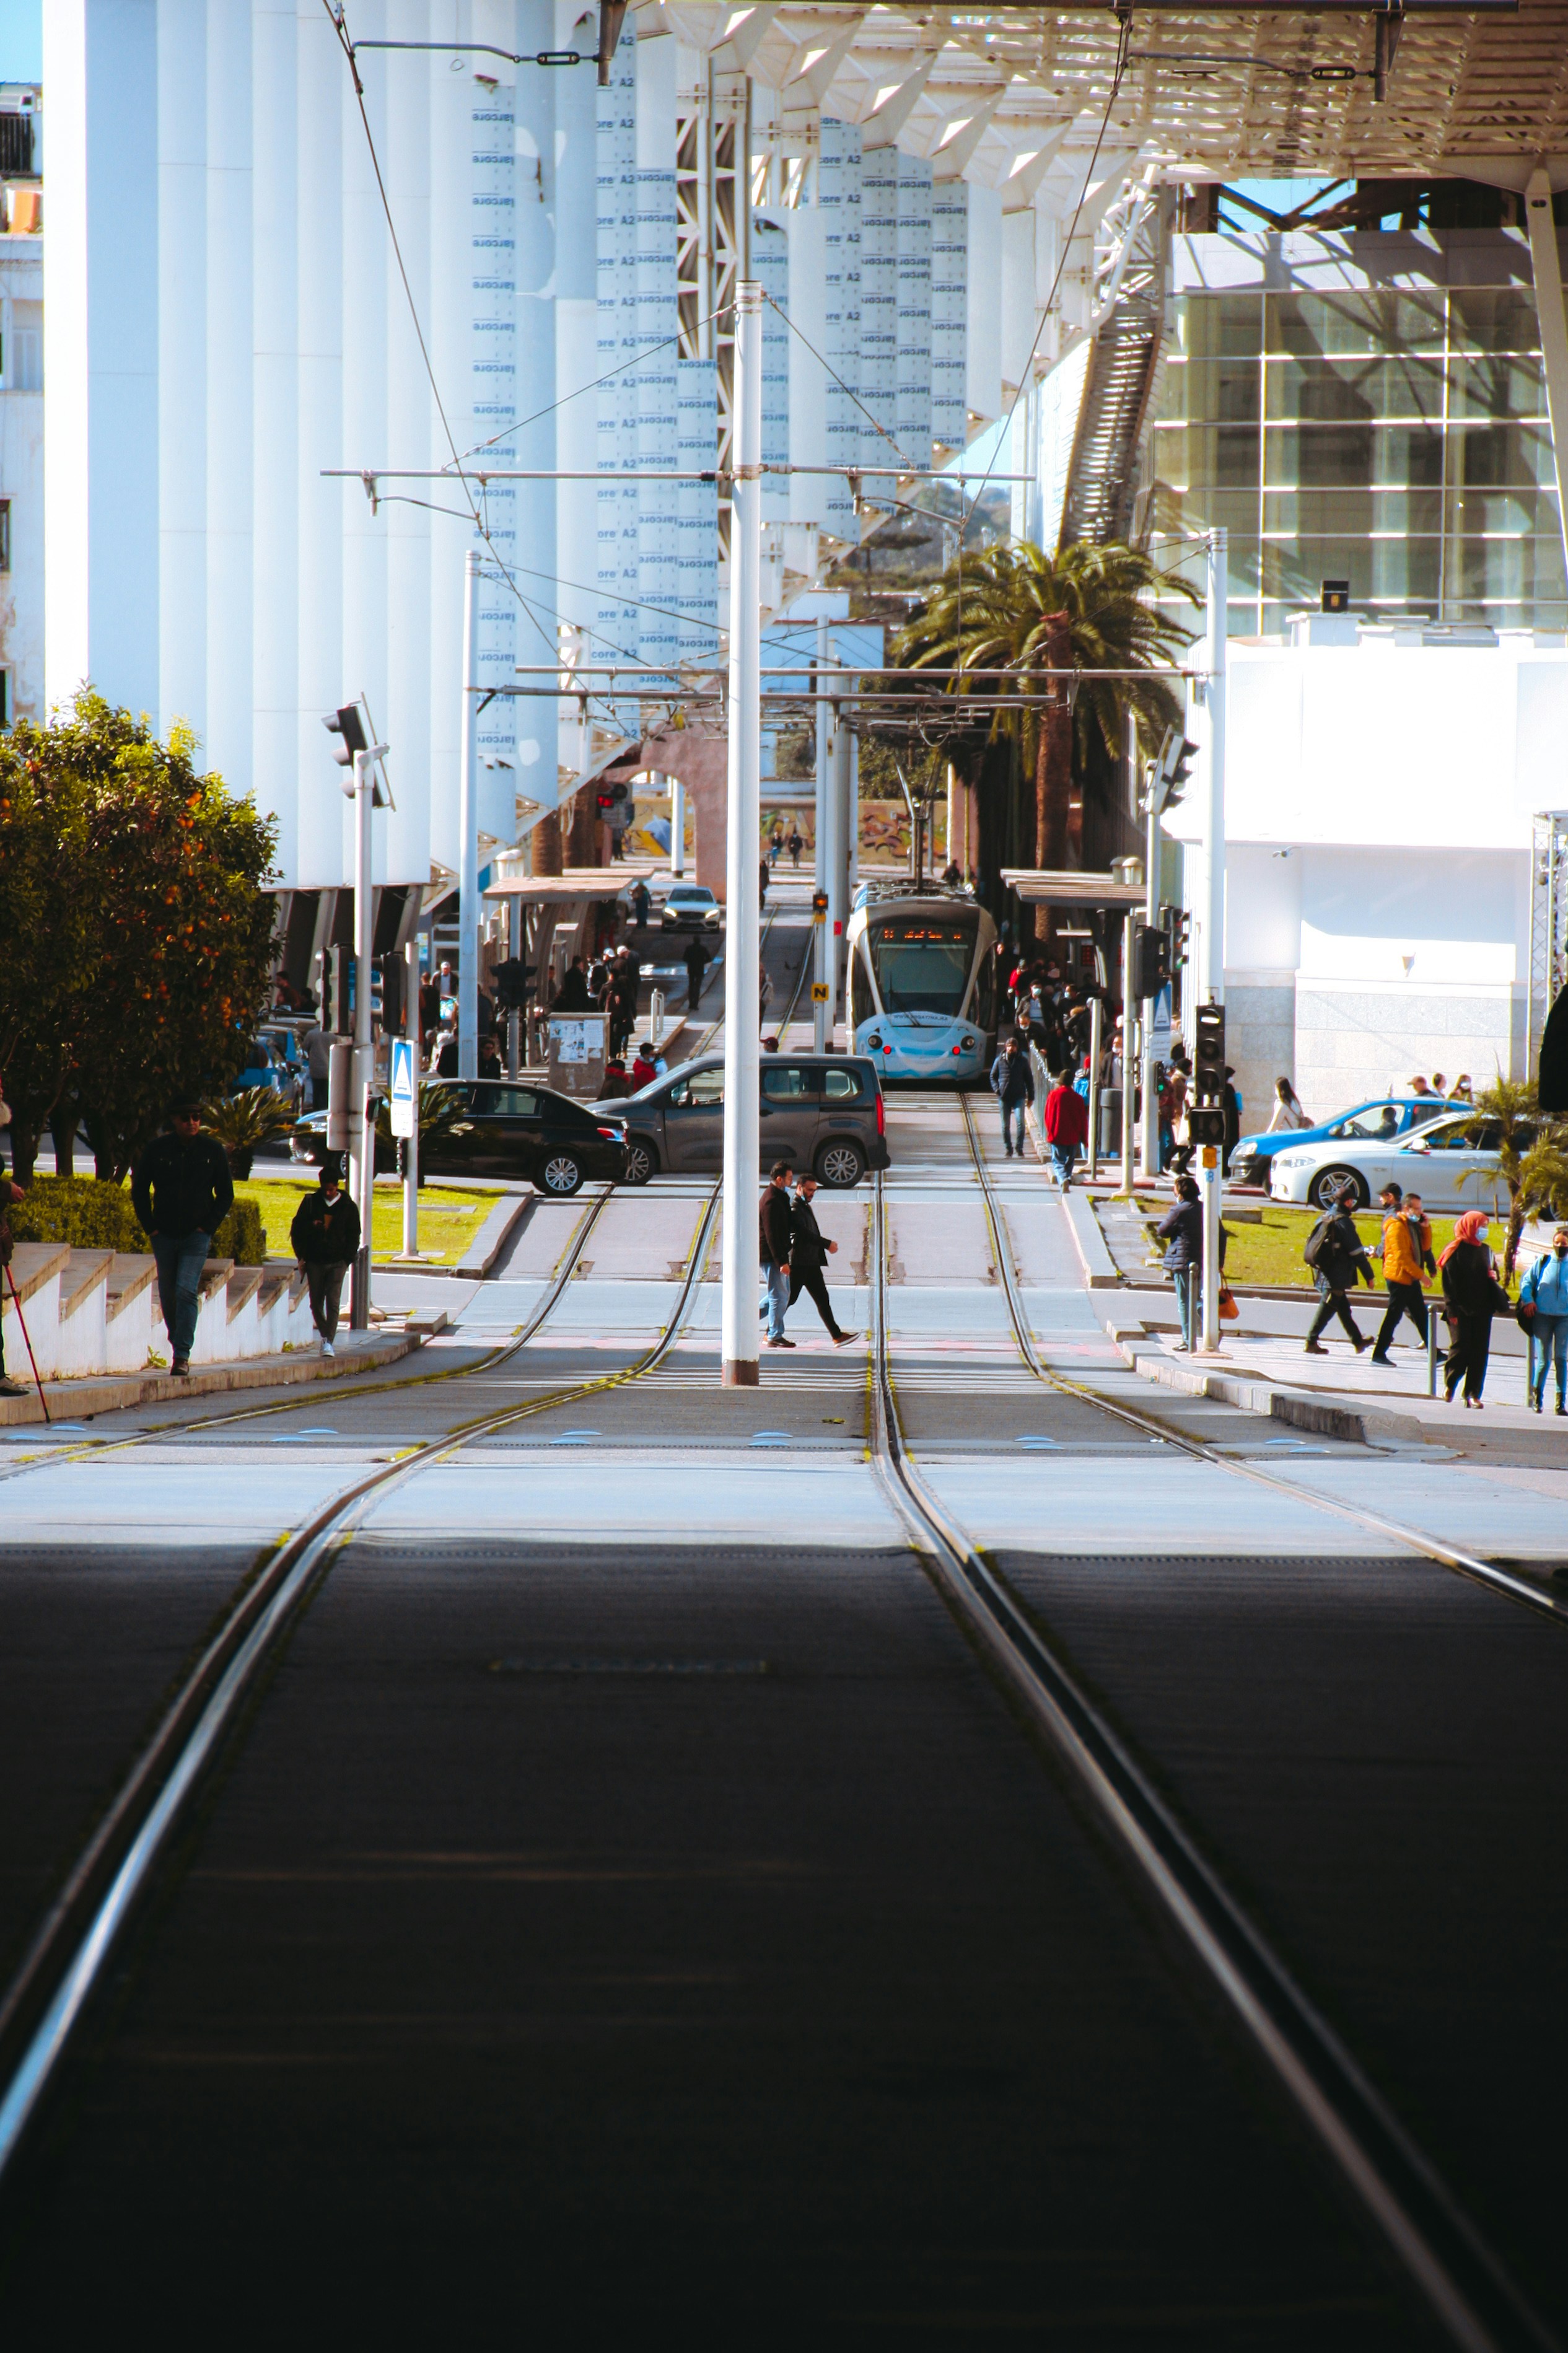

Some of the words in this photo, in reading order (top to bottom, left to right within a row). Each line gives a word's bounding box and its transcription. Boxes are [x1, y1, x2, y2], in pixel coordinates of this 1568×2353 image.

[620, 36, 634, 47] A2
[620, 77, 634, 89] A2
[472, 113, 515, 123] larcore
[620, 118, 635, 129] A2
[472, 155, 515, 165] larcore
[848, 154, 861, 165] A2
[620, 174, 635, 185] A2
[861, 180, 896, 190] larcor
[472, 197, 515, 207] larcore
[848, 194, 861, 204] A2
[932, 206, 966, 216] larcor
[621, 214, 635, 226] A2
[861, 219, 896, 229] larcor
[847, 233, 861, 243] A2
[472, 239, 515, 249] larcore
[932, 245, 966, 255] larcor
[621, 256, 635, 267] A2
[753, 256, 788, 265] larcor
[861, 257, 896, 267] larcor
[847, 272, 861, 283] A2
[472, 281, 515, 291] larcore
[933, 284, 966, 294] larcor
[621, 297, 636, 308] A2
[861, 296, 896, 306] larcor
[847, 311, 861, 322] A2
[472, 323, 515, 333] larcore
[933, 323, 965, 333] larcor
[621, 337, 636, 348] A2
[861, 335, 896, 344] larcor
[472, 364, 515, 374] larcore
[678, 361, 716, 370] larcore
[934, 361, 965, 370] larcor
[621, 378, 636, 389] A2
[861, 391, 895, 401] larcor
[678, 400, 716, 410] larcore
[934, 399, 965, 409] larcor
[472, 406, 515, 416] larcore
[622, 418, 636, 429] A2
[678, 440, 716, 450] larcore
[622, 458, 636, 470] A2
[678, 481, 717, 491] larcore
[622, 488, 636, 499] A2
[639, 515, 677, 525] larcore
[678, 520, 717, 530] larcore
[623, 528, 636, 539] A2
[639, 556, 677, 566] larcore
[678, 560, 717, 570] larcore
[623, 568, 636, 579] A2
[639, 595, 677, 605] larcore
[678, 600, 717, 610] larcore
[478, 612, 515, 622] larcor
[623, 608, 637, 620] A2
[639, 635, 677, 645] larcore
[679, 640, 717, 650] larcore
[478, 654, 515, 664] larcor
[591, 651, 616, 659] core
[814, 988, 826, 998] N
